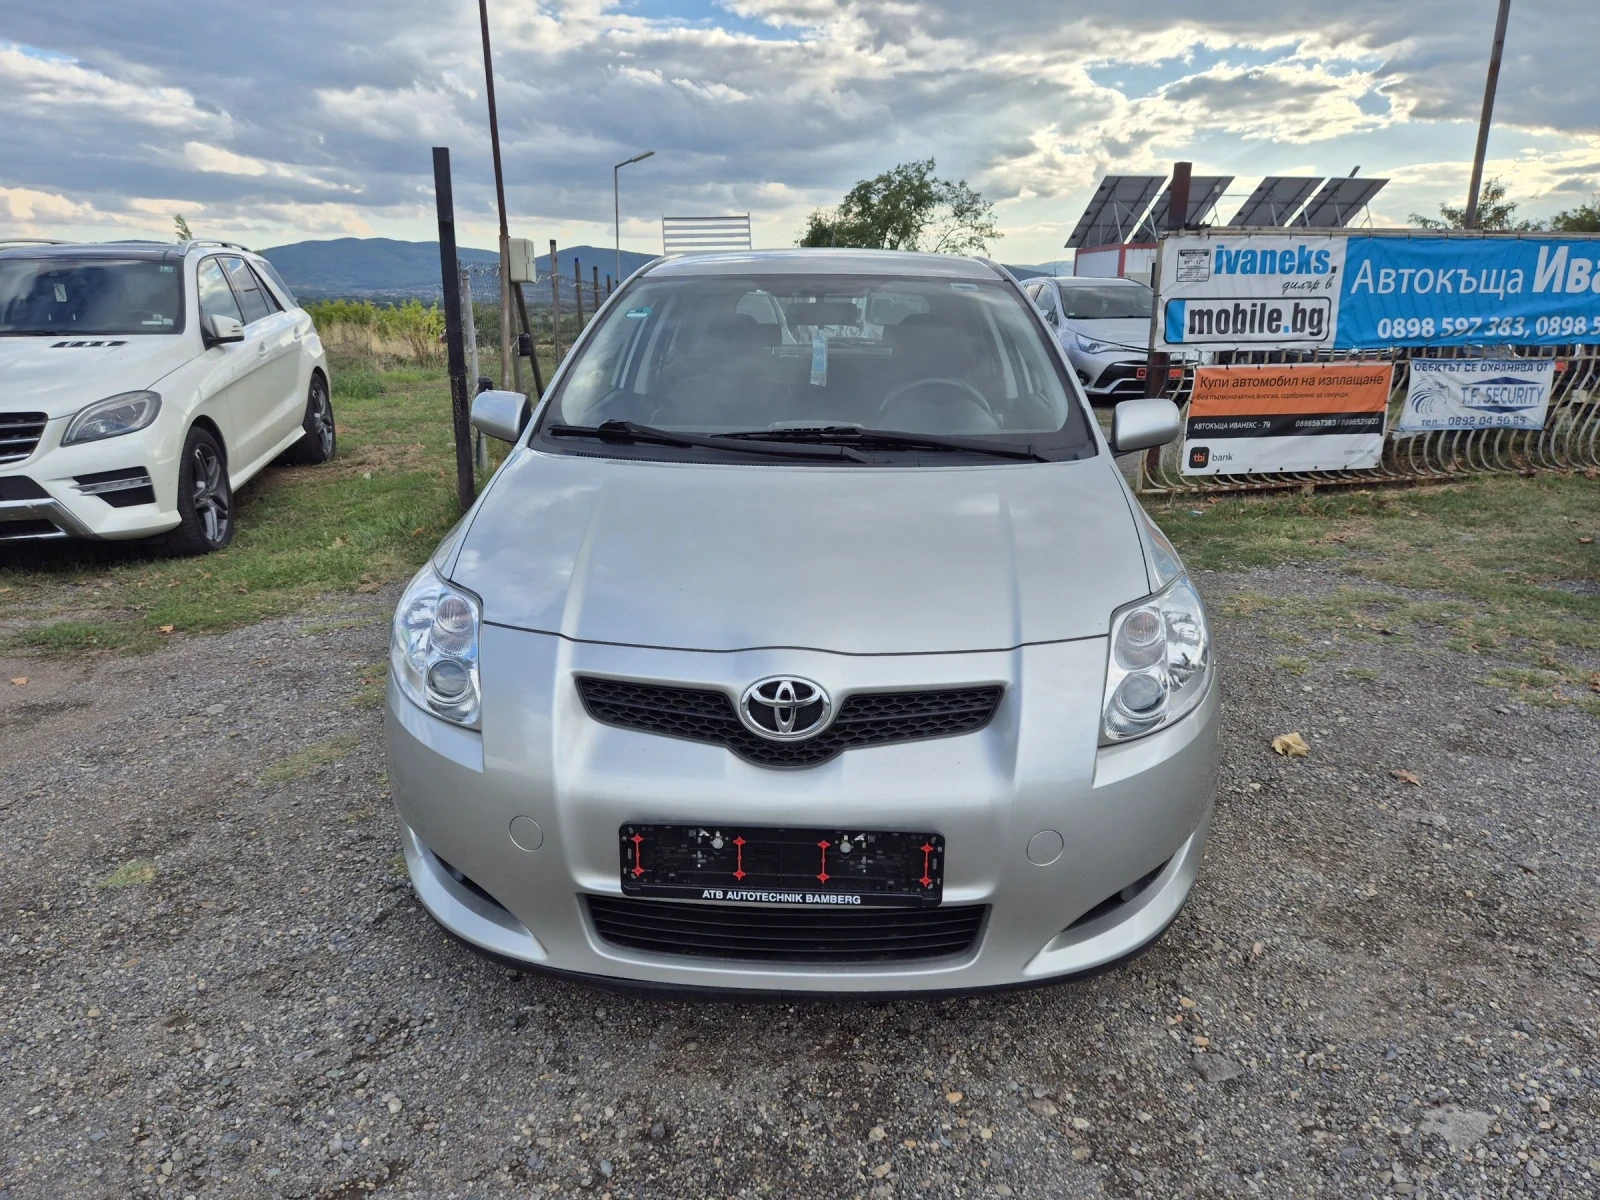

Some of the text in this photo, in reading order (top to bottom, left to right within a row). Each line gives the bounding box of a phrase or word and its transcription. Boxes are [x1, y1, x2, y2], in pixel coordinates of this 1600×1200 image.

[1350, 259, 1524, 300] Автокъща
[1188, 303, 1324, 336] mobile.bg
[1377, 317, 1435, 338] 0898
[1440, 317, 1482, 337] 597
[1484, 316, 1530, 339] 383,
[1535, 316, 1587, 336] 0898
[1464, 364, 1477, 372] СЕ
[1480, 363, 1533, 372] ОХРАНЯВА
[1536, 363, 1549, 372] ОТ
[1200, 375, 1384, 390] Купи автомобил на изплащане
[1484, 386, 1544, 404] SECURITY
[1194, 422, 1228, 430] АВТОКЪЩА
[1229, 421, 1258, 429] ИВАНЕКС
[1448, 416, 1475, 426] 0892
[1479, 416, 1492, 425] 04
[1496, 416, 1510, 425] 50
[1193, 453, 1233, 462] tbi bank
[702, 889, 861, 904] ATB AUTOTECHNIK BAMBERG
